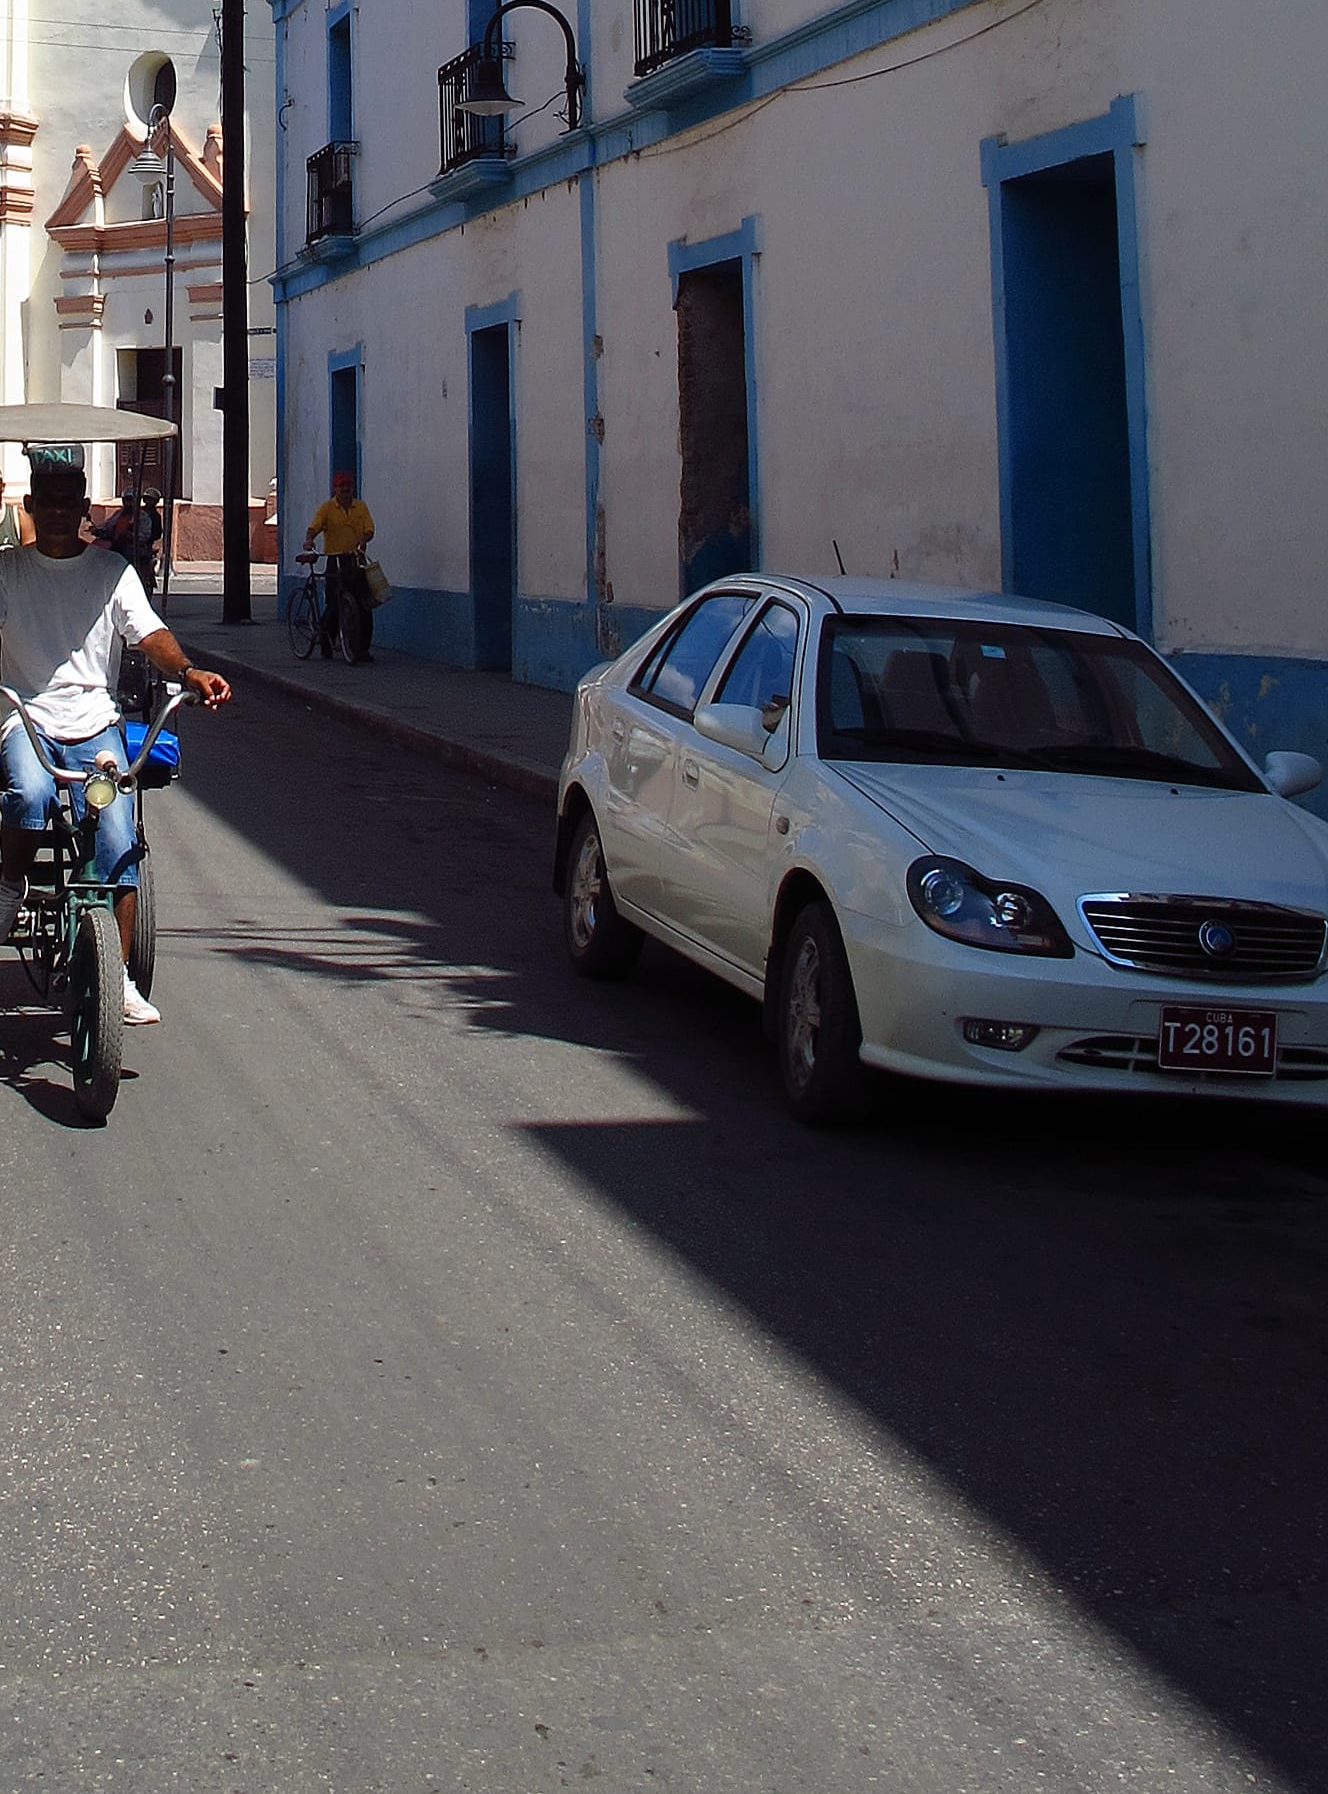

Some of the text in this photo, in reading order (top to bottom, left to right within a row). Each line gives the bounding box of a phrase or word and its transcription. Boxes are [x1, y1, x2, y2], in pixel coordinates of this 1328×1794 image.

[33, 448, 72, 463] TAXI
[1206, 1012, 1233, 1023] CUBA
[1164, 1021, 1270, 1058] T28161
